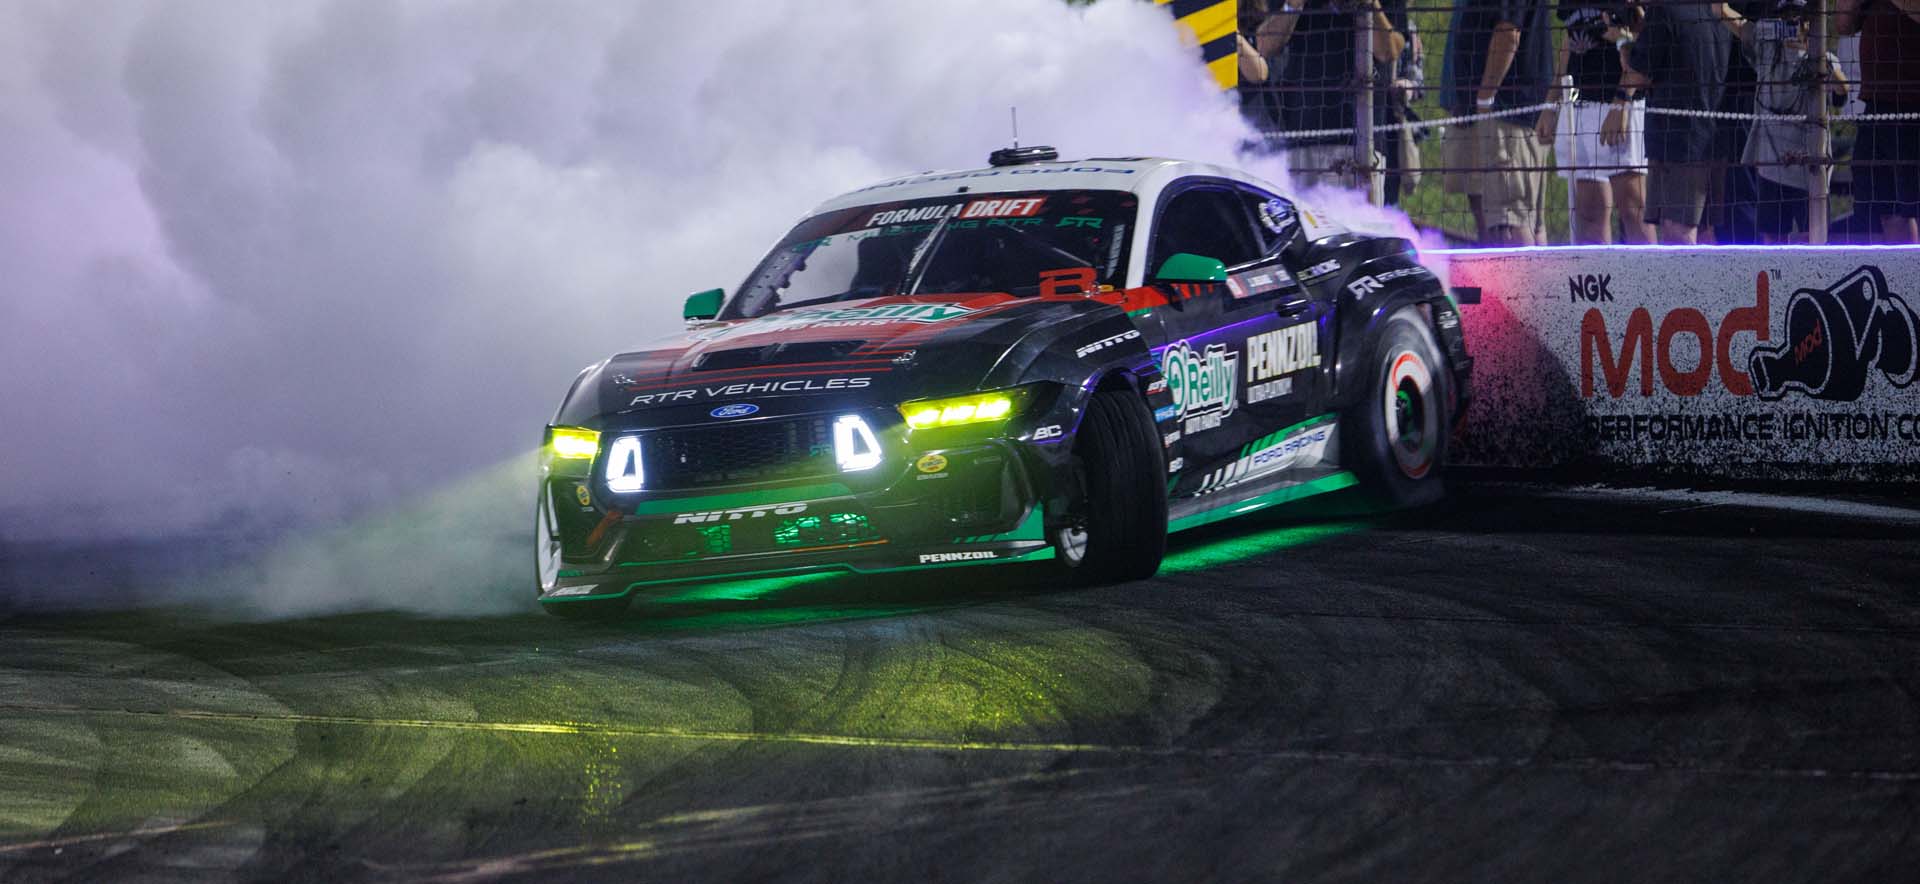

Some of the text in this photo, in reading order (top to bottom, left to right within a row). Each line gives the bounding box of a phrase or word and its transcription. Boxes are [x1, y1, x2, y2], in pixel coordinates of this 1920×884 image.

[866, 198, 1043, 227] FORMULA DRIFT
[1569, 273, 1614, 302] NGK
[1075, 329, 1141, 358] NITTO
[1247, 320, 1322, 383] PENNZOIL
[630, 377, 873, 406] RTR VEHICLES
[1167, 350, 1234, 412] O'Reilly
[718, 404, 755, 417] Ford
[1033, 424, 1063, 440] BC
[1586, 413, 1773, 441] PERFORMANCE
[1783, 412, 1888, 440] IGNITION
[1254, 430, 1326, 466] FORD RACING
[673, 502, 808, 525] NITTO
[919, 551, 999, 564] PENNZOIL
